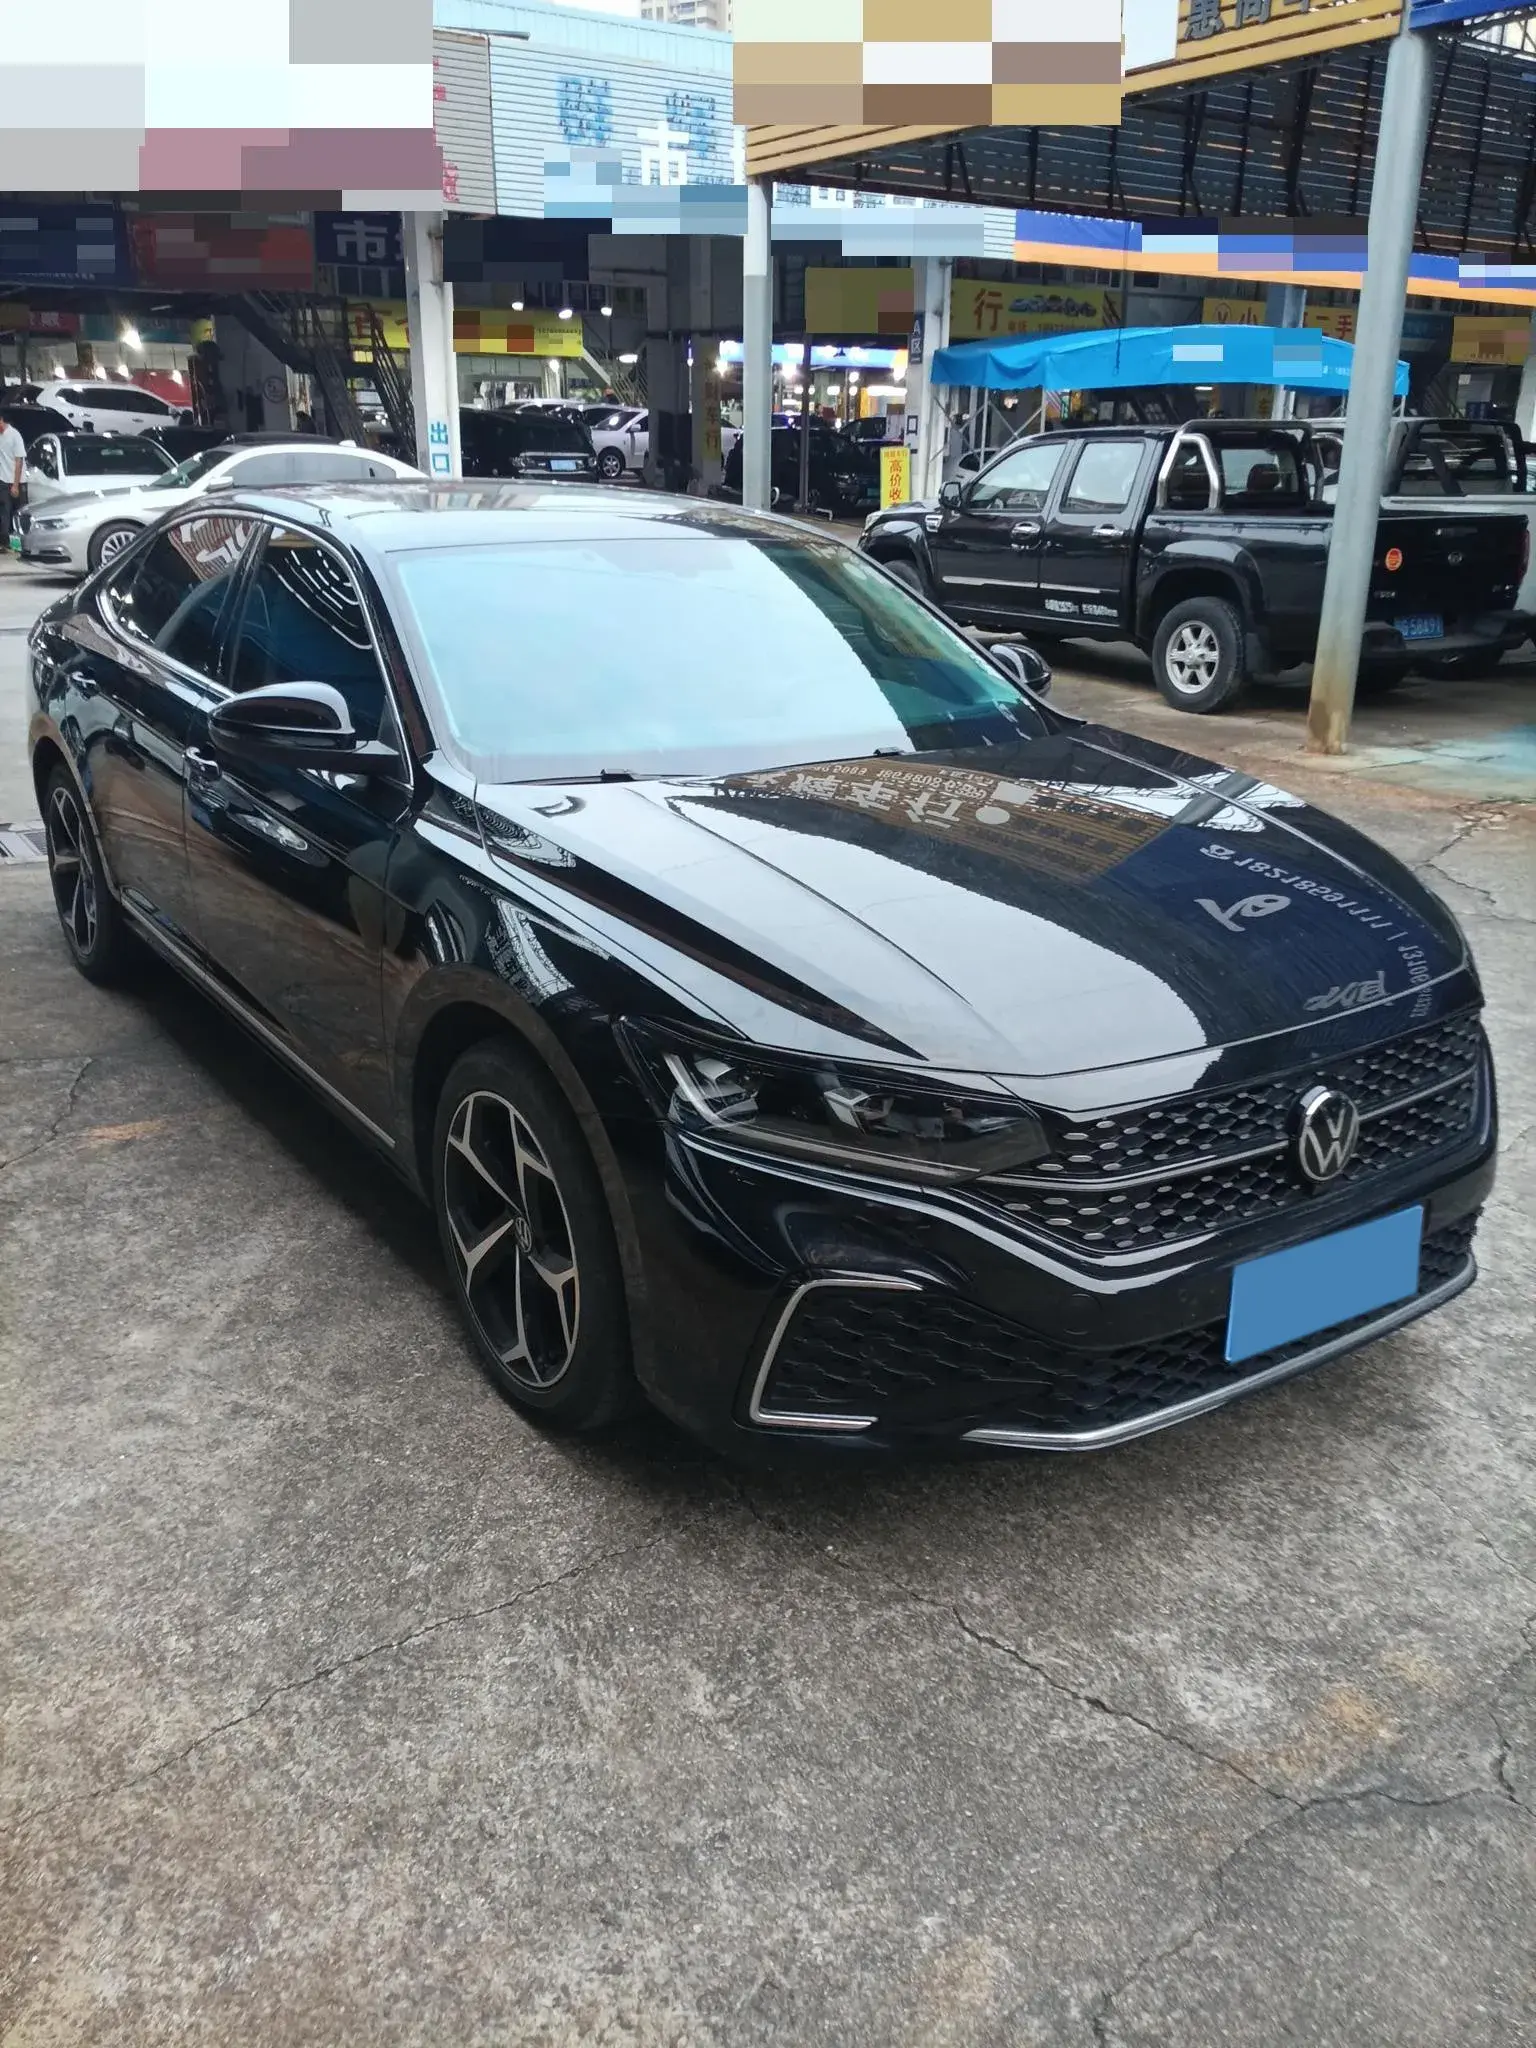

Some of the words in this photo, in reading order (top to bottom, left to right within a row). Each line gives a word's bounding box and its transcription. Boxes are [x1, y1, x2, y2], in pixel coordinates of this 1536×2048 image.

[430, 421, 450, 473] 出口
[889, 459, 903, 504] 高价收
